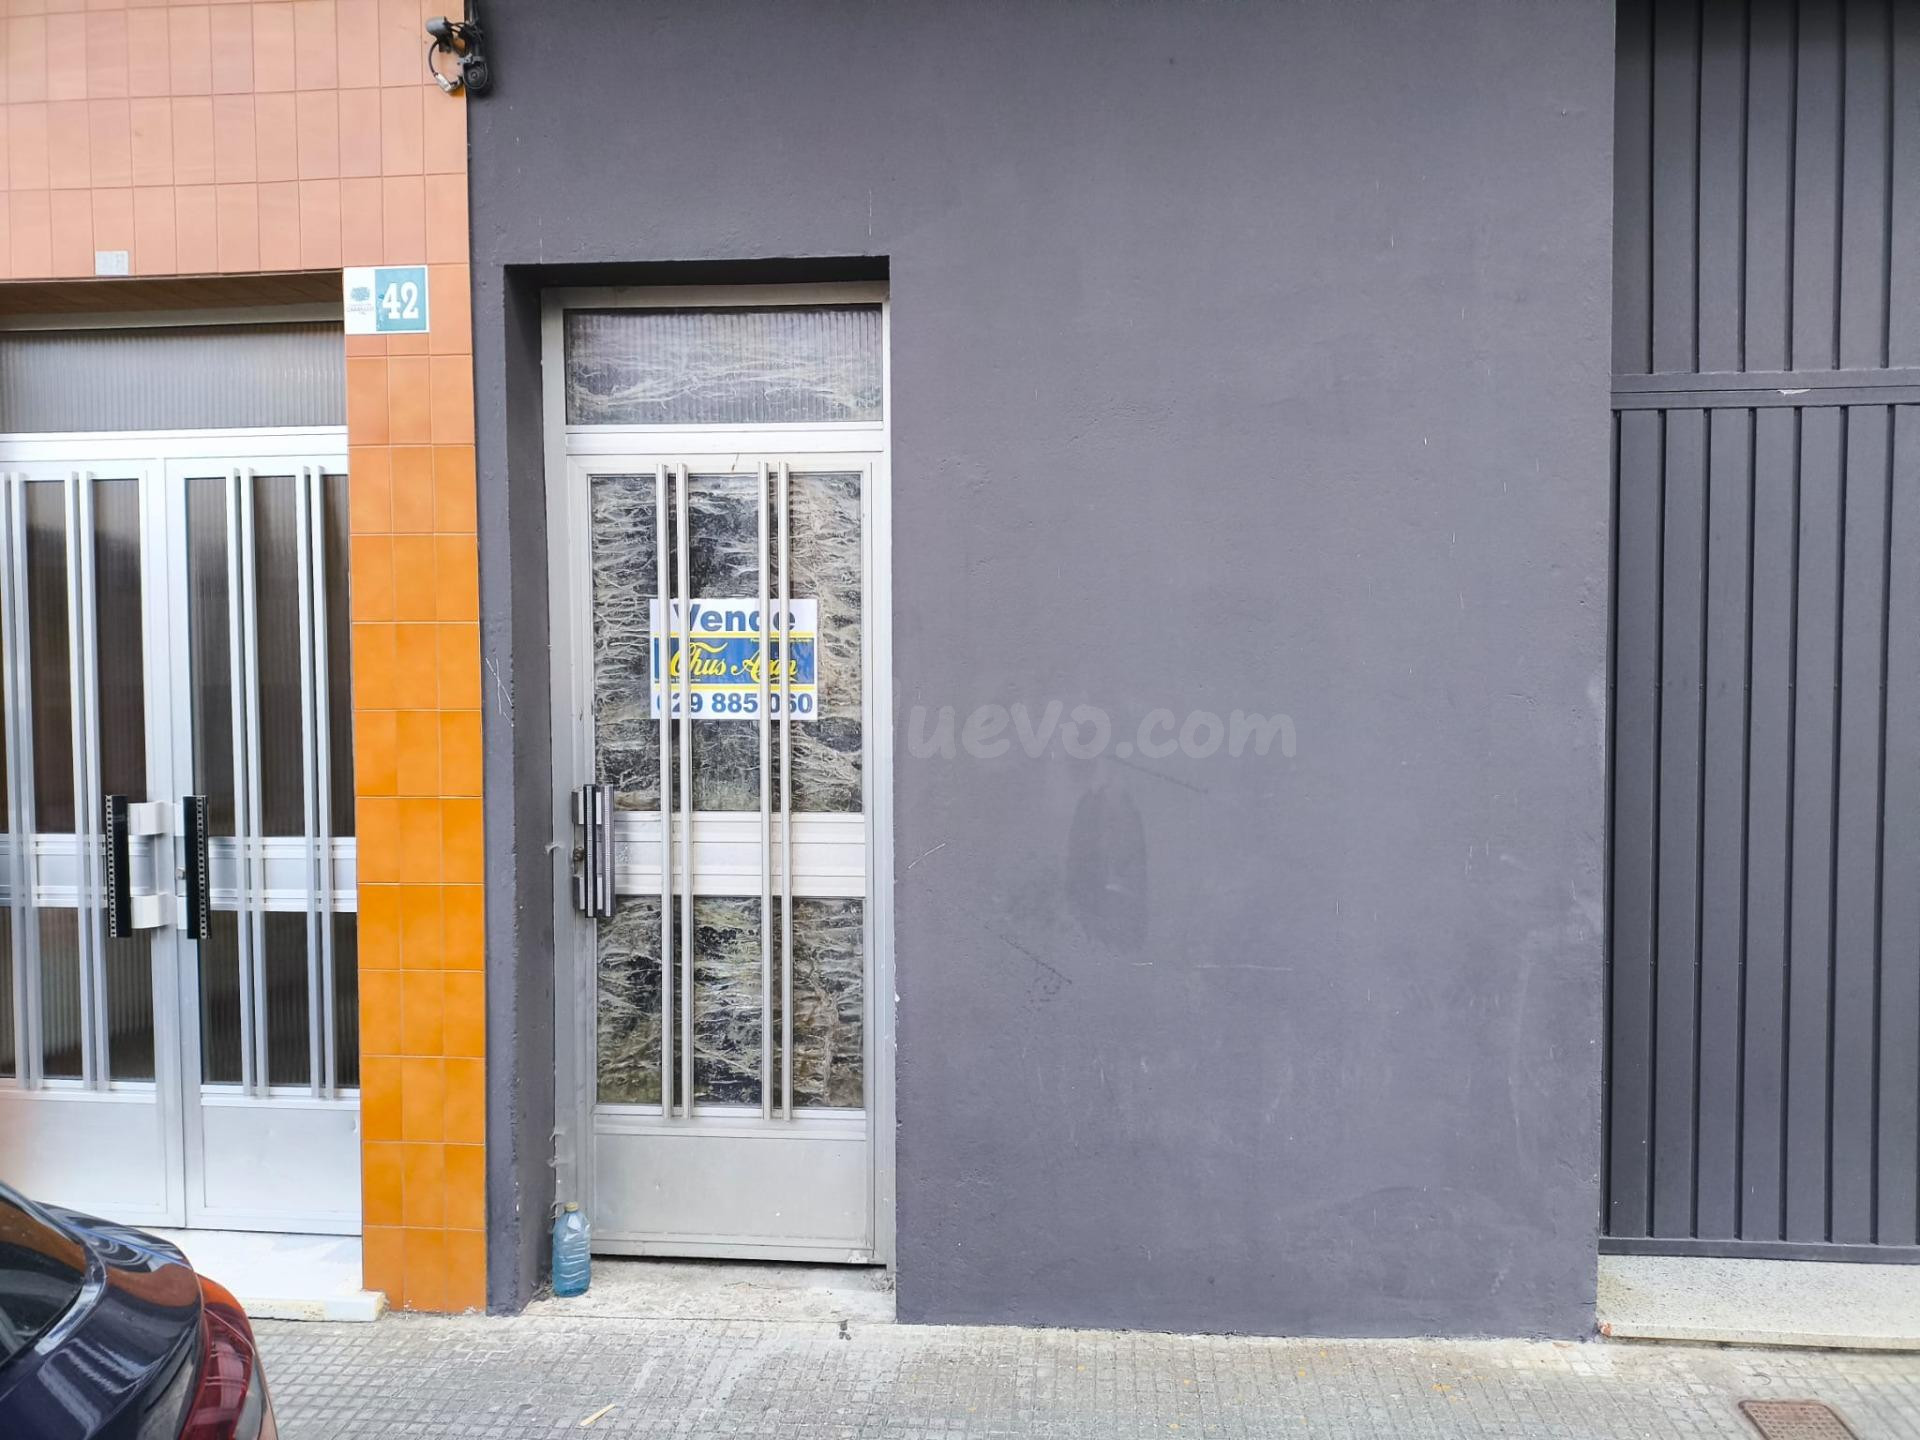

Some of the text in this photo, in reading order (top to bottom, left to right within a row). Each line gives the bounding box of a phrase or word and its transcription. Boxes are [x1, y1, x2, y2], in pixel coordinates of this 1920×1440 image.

[382, 281, 419, 320] 42
[656, 693, 703, 714] 29
[712, 692, 758, 714] 885
